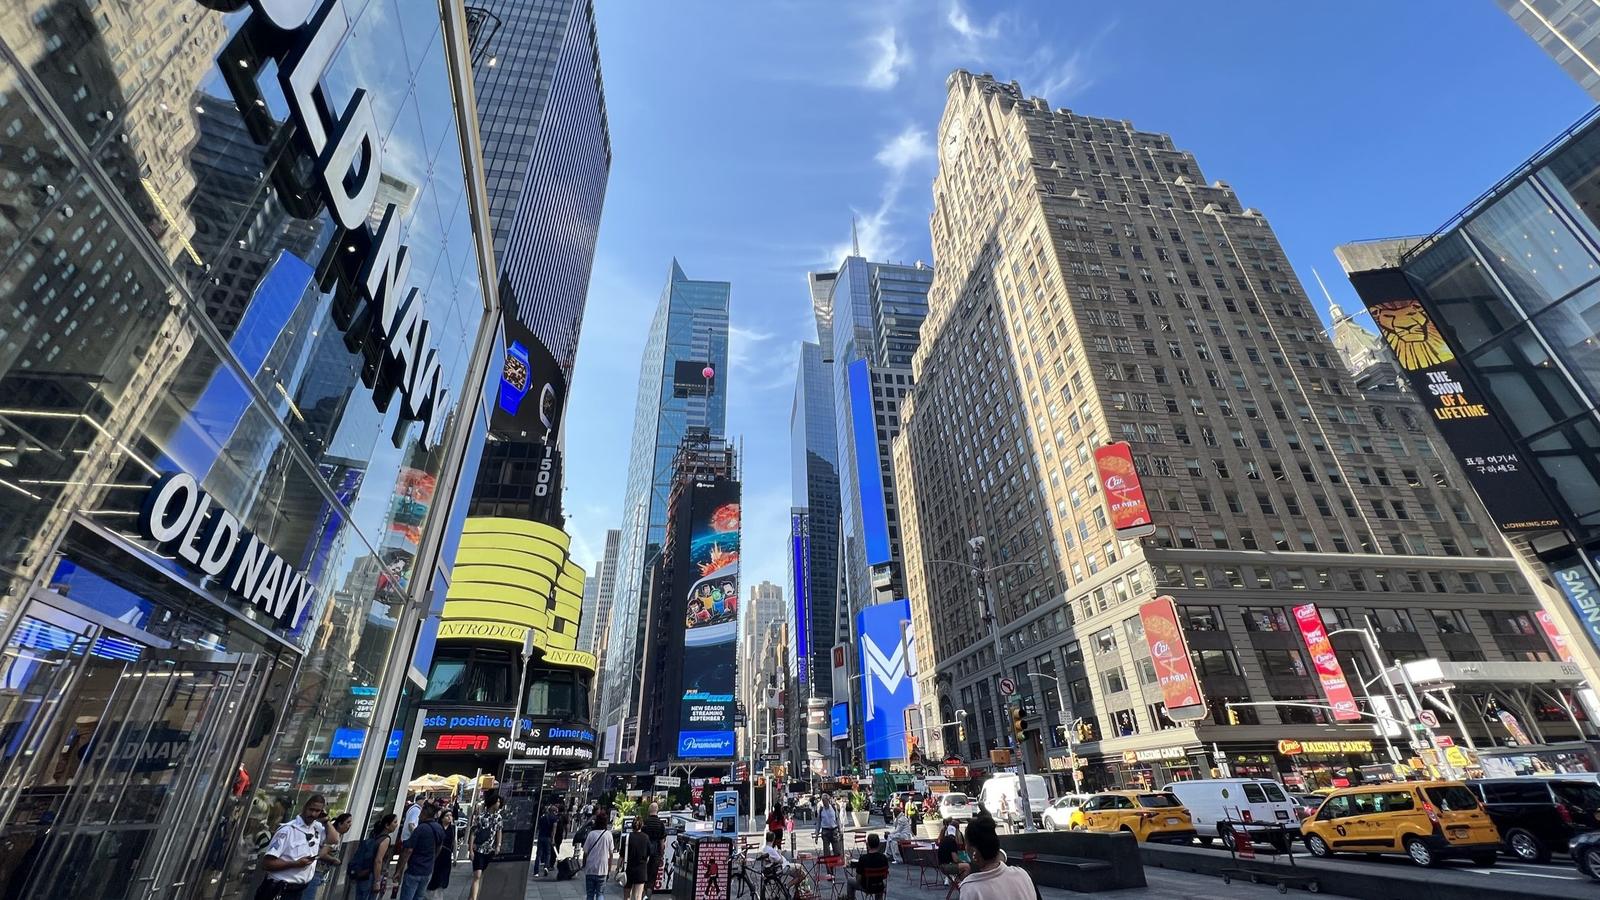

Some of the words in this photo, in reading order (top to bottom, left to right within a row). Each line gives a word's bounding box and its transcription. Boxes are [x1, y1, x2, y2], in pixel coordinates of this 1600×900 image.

[259, 0, 383, 230] LD
[365, 203, 450, 452] NAVY
[1426, 371, 1452, 383] THE
[1428, 382, 1464, 395] SHOW
[1440, 395, 1456, 406] OF
[1457, 394, 1468, 405] A
[1434, 405, 1489, 419] LIFETIME
[1465, 457, 1485, 466] 표를
[1487, 454, 1518, 463] 여기서
[535, 446, 552, 496] 1500
[1477, 464, 1518, 474] 구하세요
[1503, 520, 1560, 529] LIONKING.COM
[150, 472, 240, 576] OLD
[231, 534, 314, 629] NAVY
[440, 624, 534, 643] INTRODUCI
[424, 715, 447, 727] ests
[450, 715, 501, 728] positive
[503, 717, 514, 727] fo
[549, 728, 580, 738] Dinner
[436, 735, 490, 750] ESPN
[498, 737, 527, 751] Sorces
[526, 745, 550, 756] amid
[552, 745, 574, 756] final
[1301, 742, 1340, 752] RAISING
[1341, 741, 1373, 752] CANE'S
